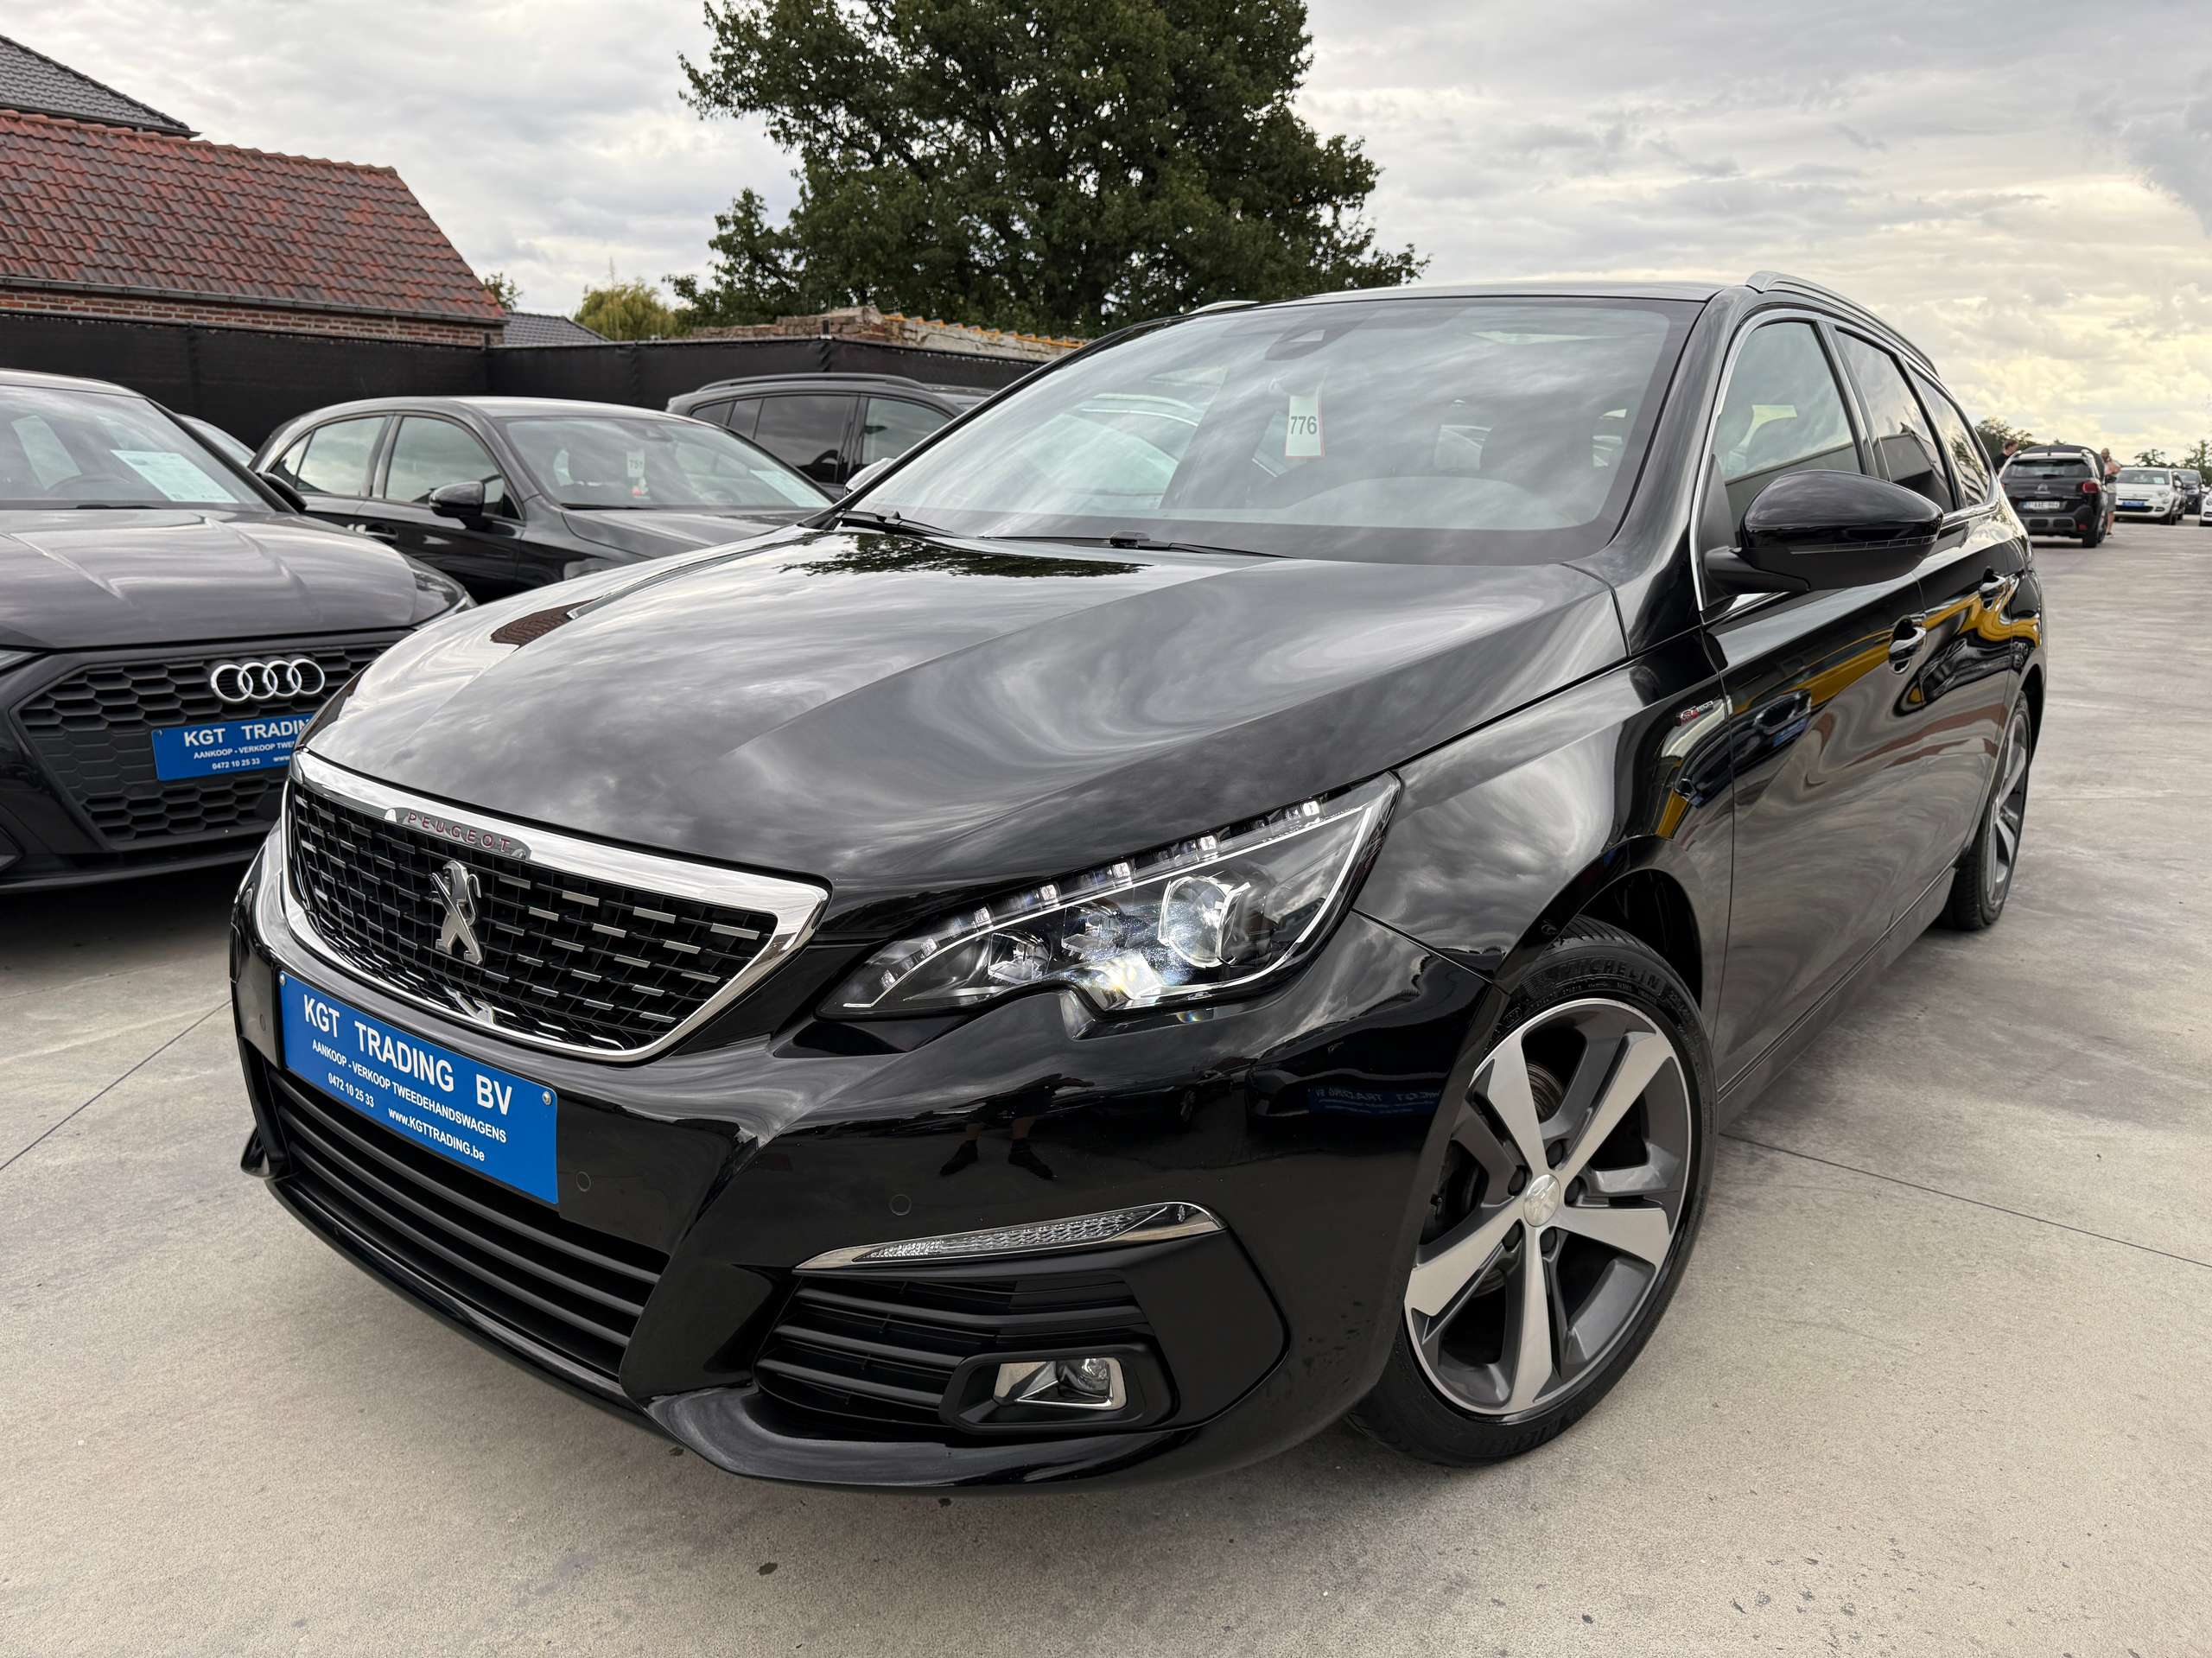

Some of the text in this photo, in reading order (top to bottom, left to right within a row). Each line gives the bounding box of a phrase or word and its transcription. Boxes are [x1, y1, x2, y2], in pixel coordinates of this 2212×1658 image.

[1290, 416, 1318, 435] 776
[183, 719, 309, 747] KGT TRADIN
[194, 748, 233, 759] AANKOOP
[238, 743, 276, 754] VERKOOP
[407, 810, 511, 854] PEUGEOT
[303, 994, 512, 1116] KGT TRADING BV
[312, 1039, 347, 1068] AANKOOP
[352, 1060, 391, 1090] VERKOOP
[391, 1081, 507, 1144] TWEEDEHANDSWAGENS
[327, 1072, 374, 1109] 0472 10 25 33
[388, 1108, 485, 1162] www.KGTTRADING.be
